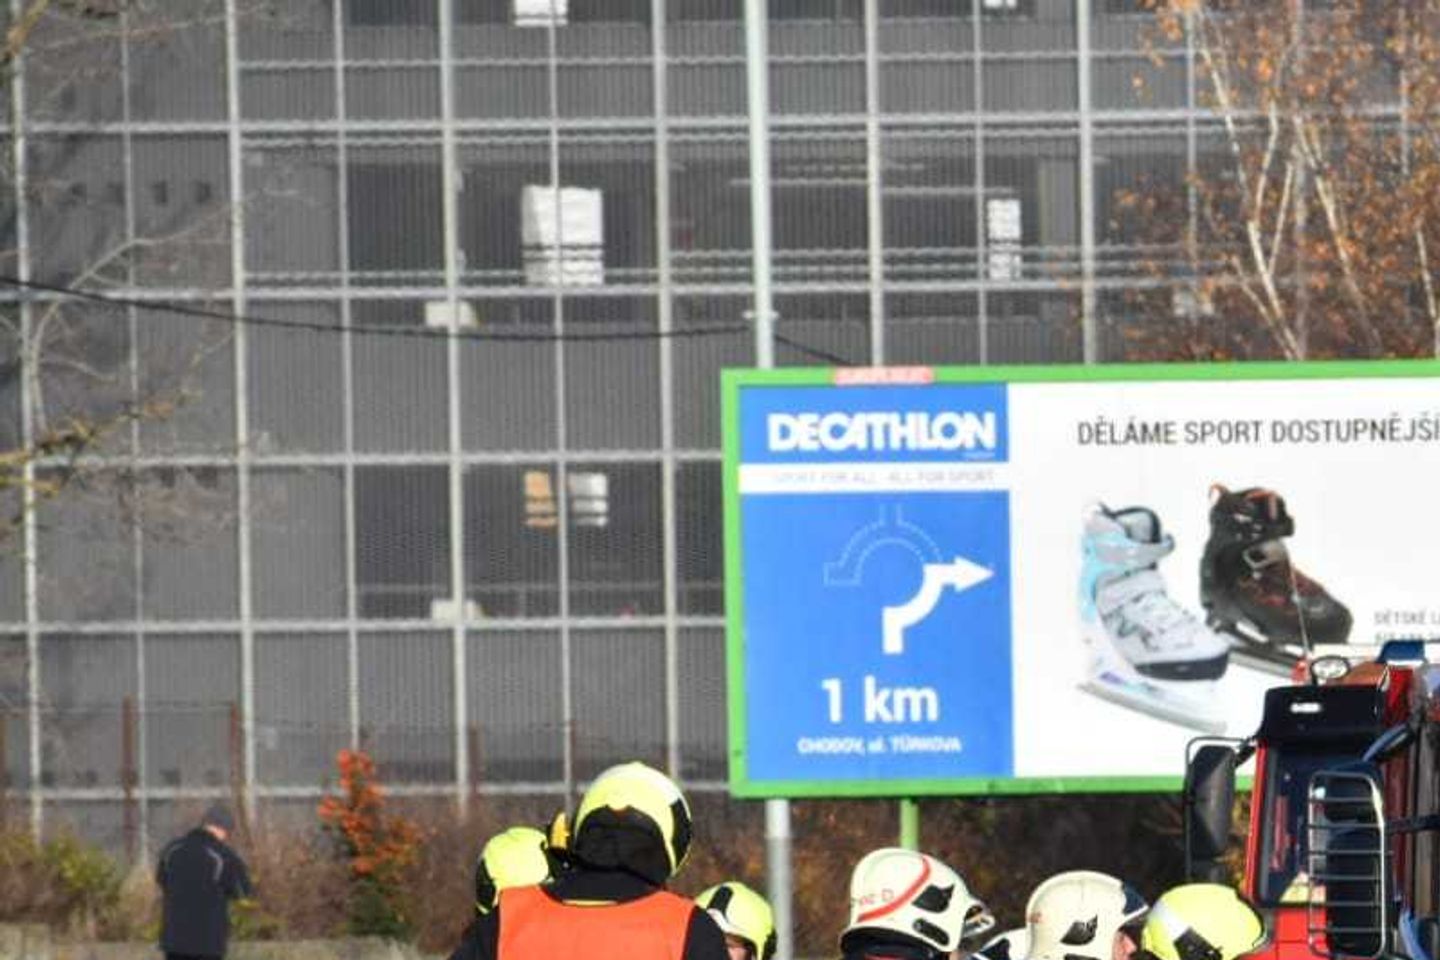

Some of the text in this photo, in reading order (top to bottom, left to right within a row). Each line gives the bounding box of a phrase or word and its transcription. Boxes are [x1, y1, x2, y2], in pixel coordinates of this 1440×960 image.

[768, 411, 996, 452] DECATHLON
[1077, 415, 1176, 446] DĚLÁME
[1184, 418, 1263, 445] SPORT
[1271, 411, 1440, 443] DOSTUPNĚJŠÍ
[821, 674, 939, 723] 1 km
